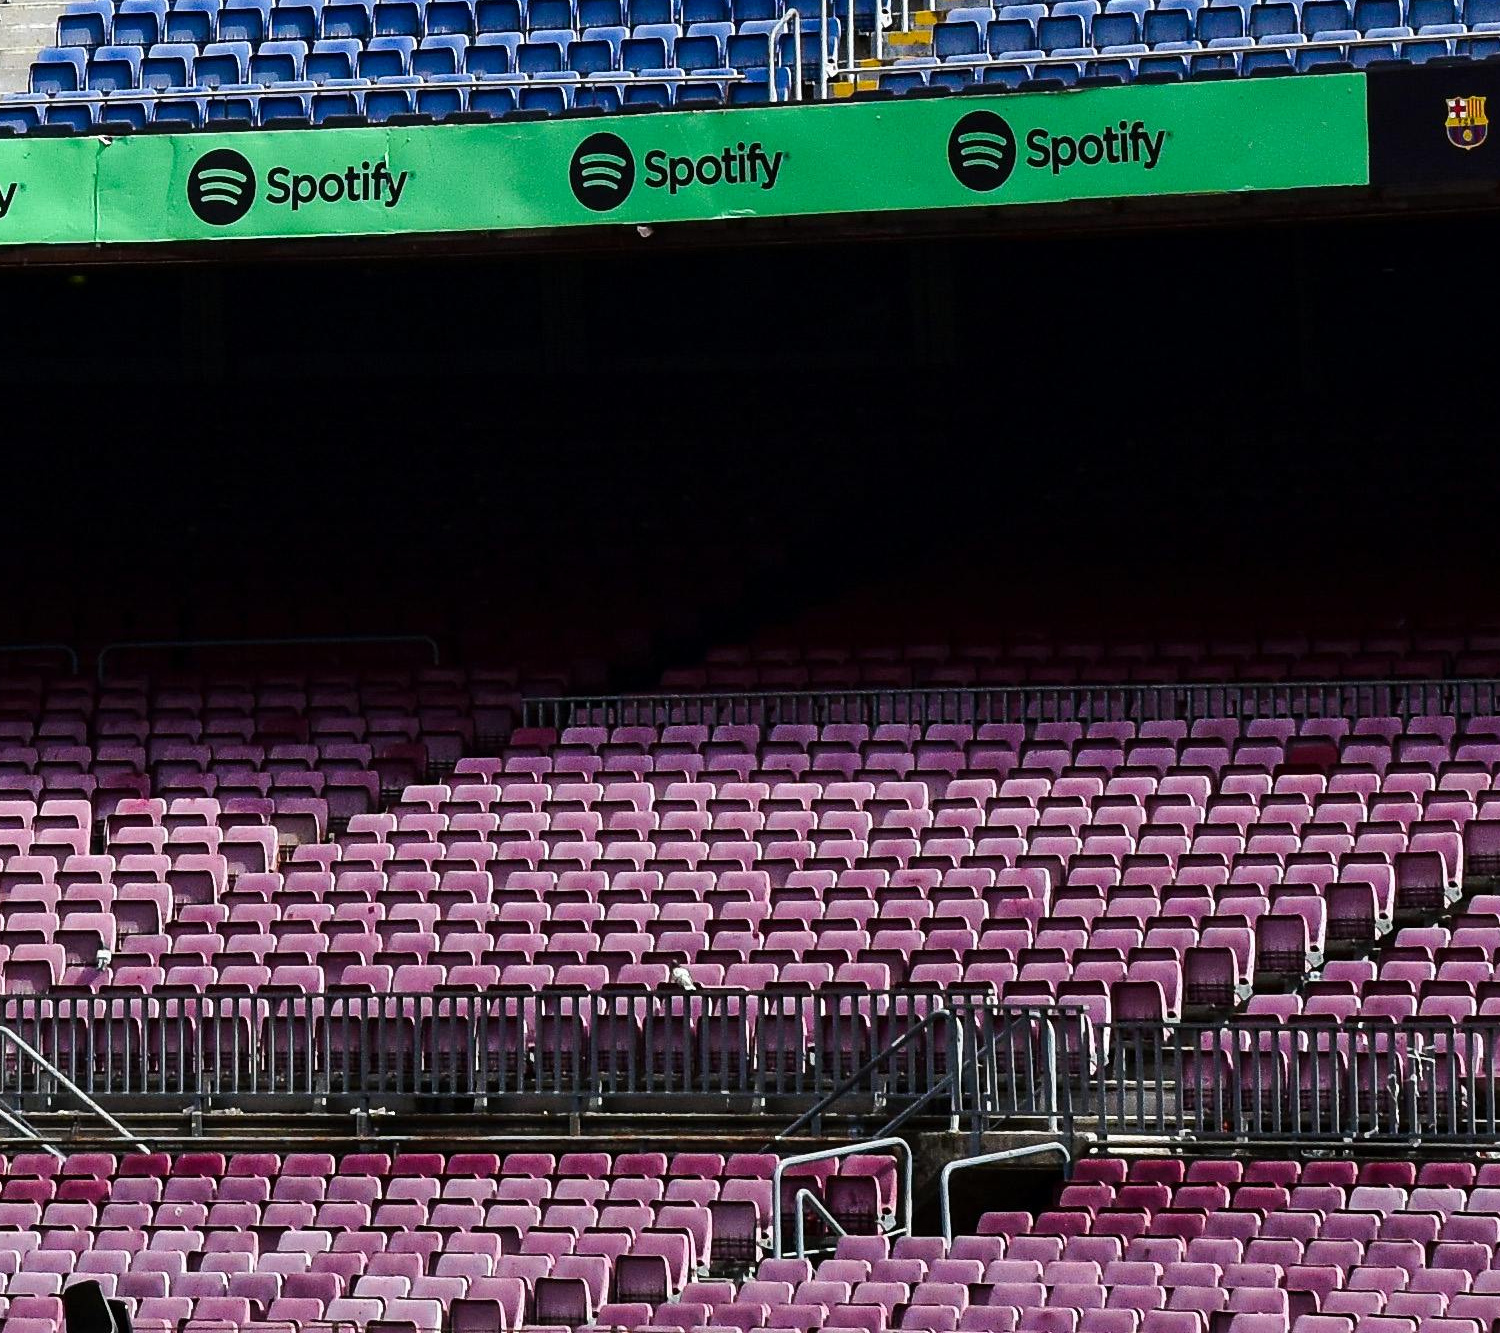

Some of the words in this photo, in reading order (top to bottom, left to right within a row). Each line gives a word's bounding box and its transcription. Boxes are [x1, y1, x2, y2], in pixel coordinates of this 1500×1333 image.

[644, 142, 784, 194] Spotify
[1025, 118, 1167, 174] Spotify
[266, 161, 408, 210] Spotify
